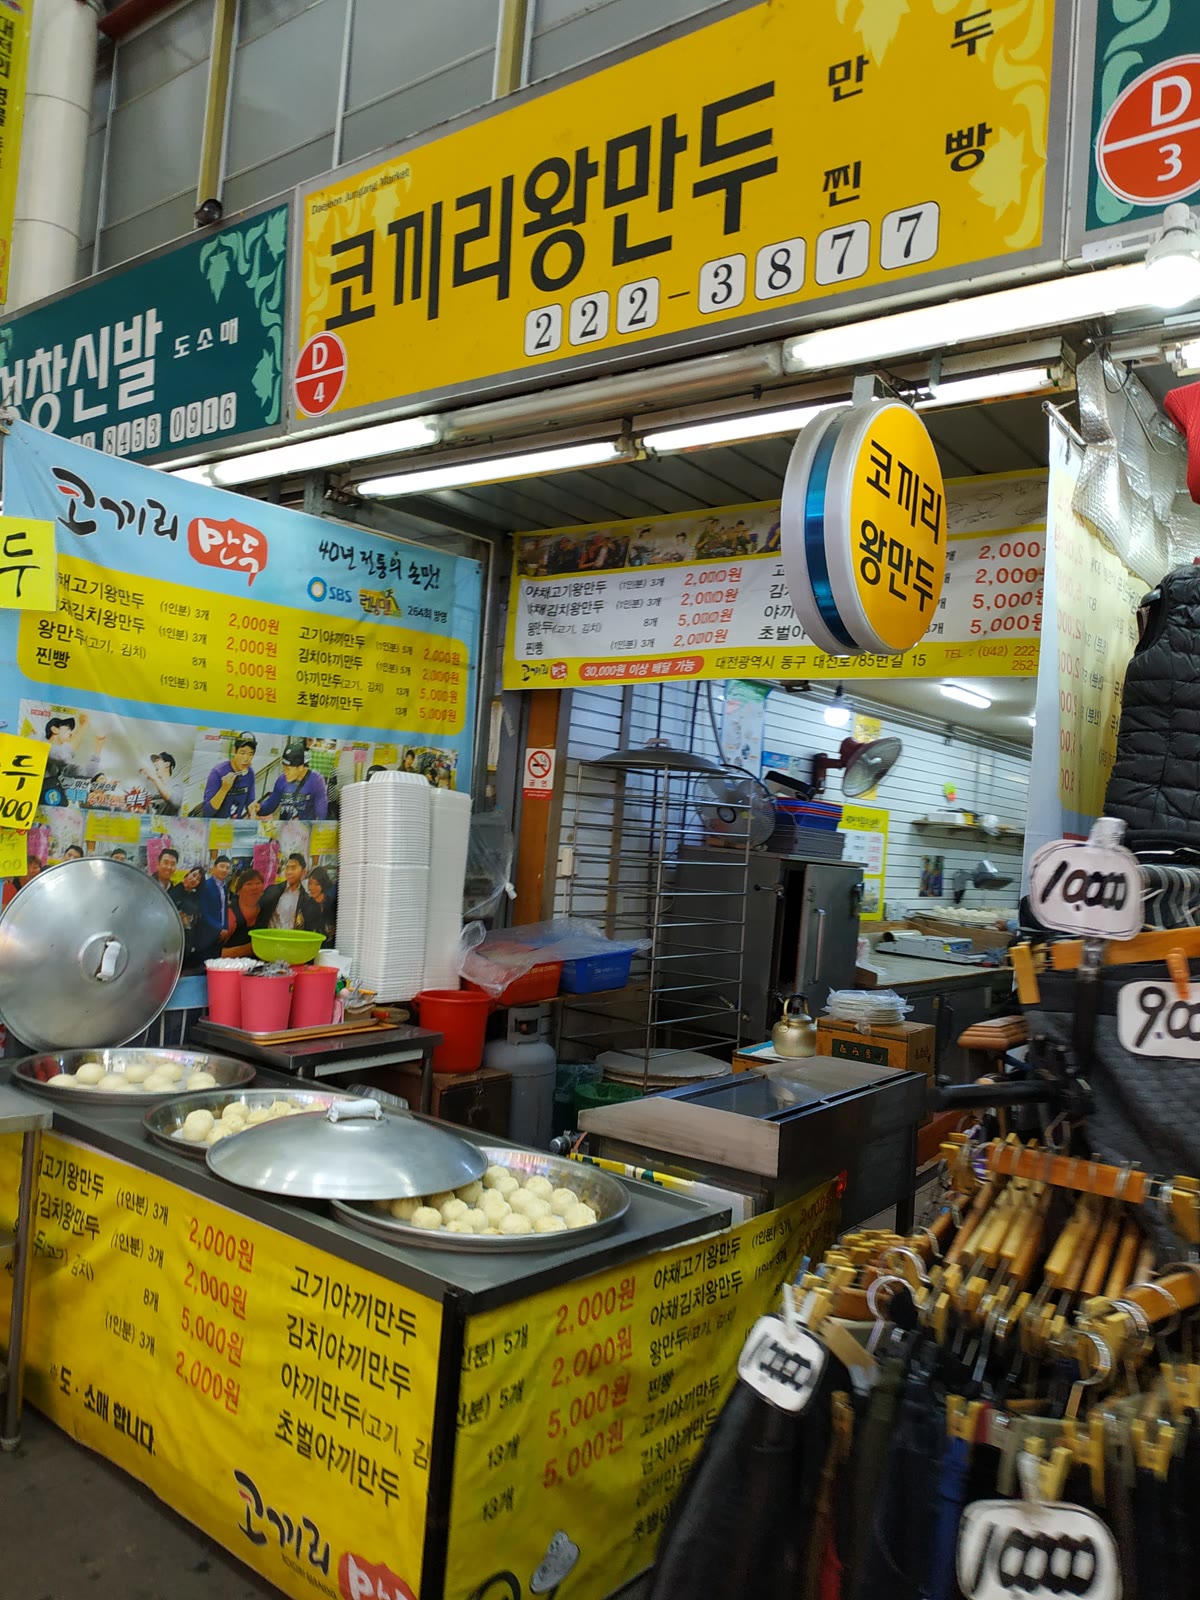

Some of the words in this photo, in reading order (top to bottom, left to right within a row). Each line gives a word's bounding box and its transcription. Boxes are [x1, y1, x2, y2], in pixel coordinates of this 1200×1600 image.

[1150, 76, 1193, 128] D
[380, 167, 410, 187] Market
[1156, 143, 1184, 183] 3
[325, 80, 778, 330] 코끼리왕만두
[530, 207, 930, 352] 222-3877
[173, 317, 240, 359] 도소매
[311, 342, 328, 370] D
[170, 392, 237, 443] 0916
[313, 383, 326, 404] 4
[52, 467, 178, 541] 코끼리
[866, 439, 942, 545] 코끼리
[0, 532, 41, 598] 두
[859, 519, 936, 613] 왕만두
[979, 541, 1046, 561] 2,000
[329, 586, 353, 603] SBS
[525, 581, 608, 600] 야채고기왕만두
[650, 577, 665, 587] 3개
[684, 567, 743, 587] 2,000원
[680, 588, 739, 607] 2,000원
[158, 626, 189, 641] (1인분)
[192, 633, 208, 645] 3개
[226, 637, 278, 658] 2,000원
[160, 600, 191, 618] (1인분)
[195, 608, 210, 621] 3개
[228, 613, 280, 636] 2,000원
[299, 627, 366, 650] 고기야끼만두
[643, 617, 658, 628] 8개
[677, 608, 734, 627] 5,000원
[673, 628, 729, 648] 2,000원
[36, 646, 71, 669] 찐빵
[160, 675, 190, 691] (1인분)
[193, 680, 208, 692] 3개
[226, 684, 278, 704] 2,000원
[192, 657, 207, 669] 8개
[225, 660, 277, 682] 5,000원
[298, 648, 363, 671] 김치야끼만두
[584, 663, 626, 678] 30,000원
[629, 661, 650, 676] 이상
[652, 661, 673, 675] 배달
[674, 659, 696, 673] 가능
[716, 655, 776, 671] 대전광역시
[781, 655, 807, 670] 동구
[912, 654, 927, 667] 15
[945, 649, 963, 660] TEL
[978, 645, 1008, 658] (042)
[297, 691, 364, 712] 초벌야끼만두
[39, 1151, 105, 1200] 고기왕만두
[116, 1187, 149, 1217] (1인분)
[153, 1203, 169, 1227] 3개
[189, 1217, 254, 1273] 2,000원
[35, 1188, 101, 1241] 김치왕만두
[110, 1229, 144, 1259] (1인분)
[148, 1245, 164, 1269] 3개
[184, 1262, 248, 1321] 2,000원
[653, 1236, 741, 1291] 야채고기왕만두
[290, 1266, 417, 1346] 고기야끼만두
[503, 1322, 529, 1356] 5개
[556, 1275, 636, 1337] 2,000원
[650, 1270, 744, 1327] 야채김치왕만두
[143, 1288, 159, 1312] 8개
[181, 1305, 245, 1368] 5,000원
[105, 1311, 135, 1344] (1인분)
[139, 1331, 155, 1356] 3개
[175, 1350, 240, 1415] 2,000원
[286, 1313, 411, 1400] 김치야끼만두
[551, 1324, 633, 1388] 2,000원
[547, 1372, 632, 1440] 5,000원
[640, 1374, 721, 1438] 고기야끼만두
[275, 1409, 400, 1508] 초벌야끼만두
[543, 1418, 624, 1490] 5,000원
[234, 1468, 329, 1577] 코끼리
